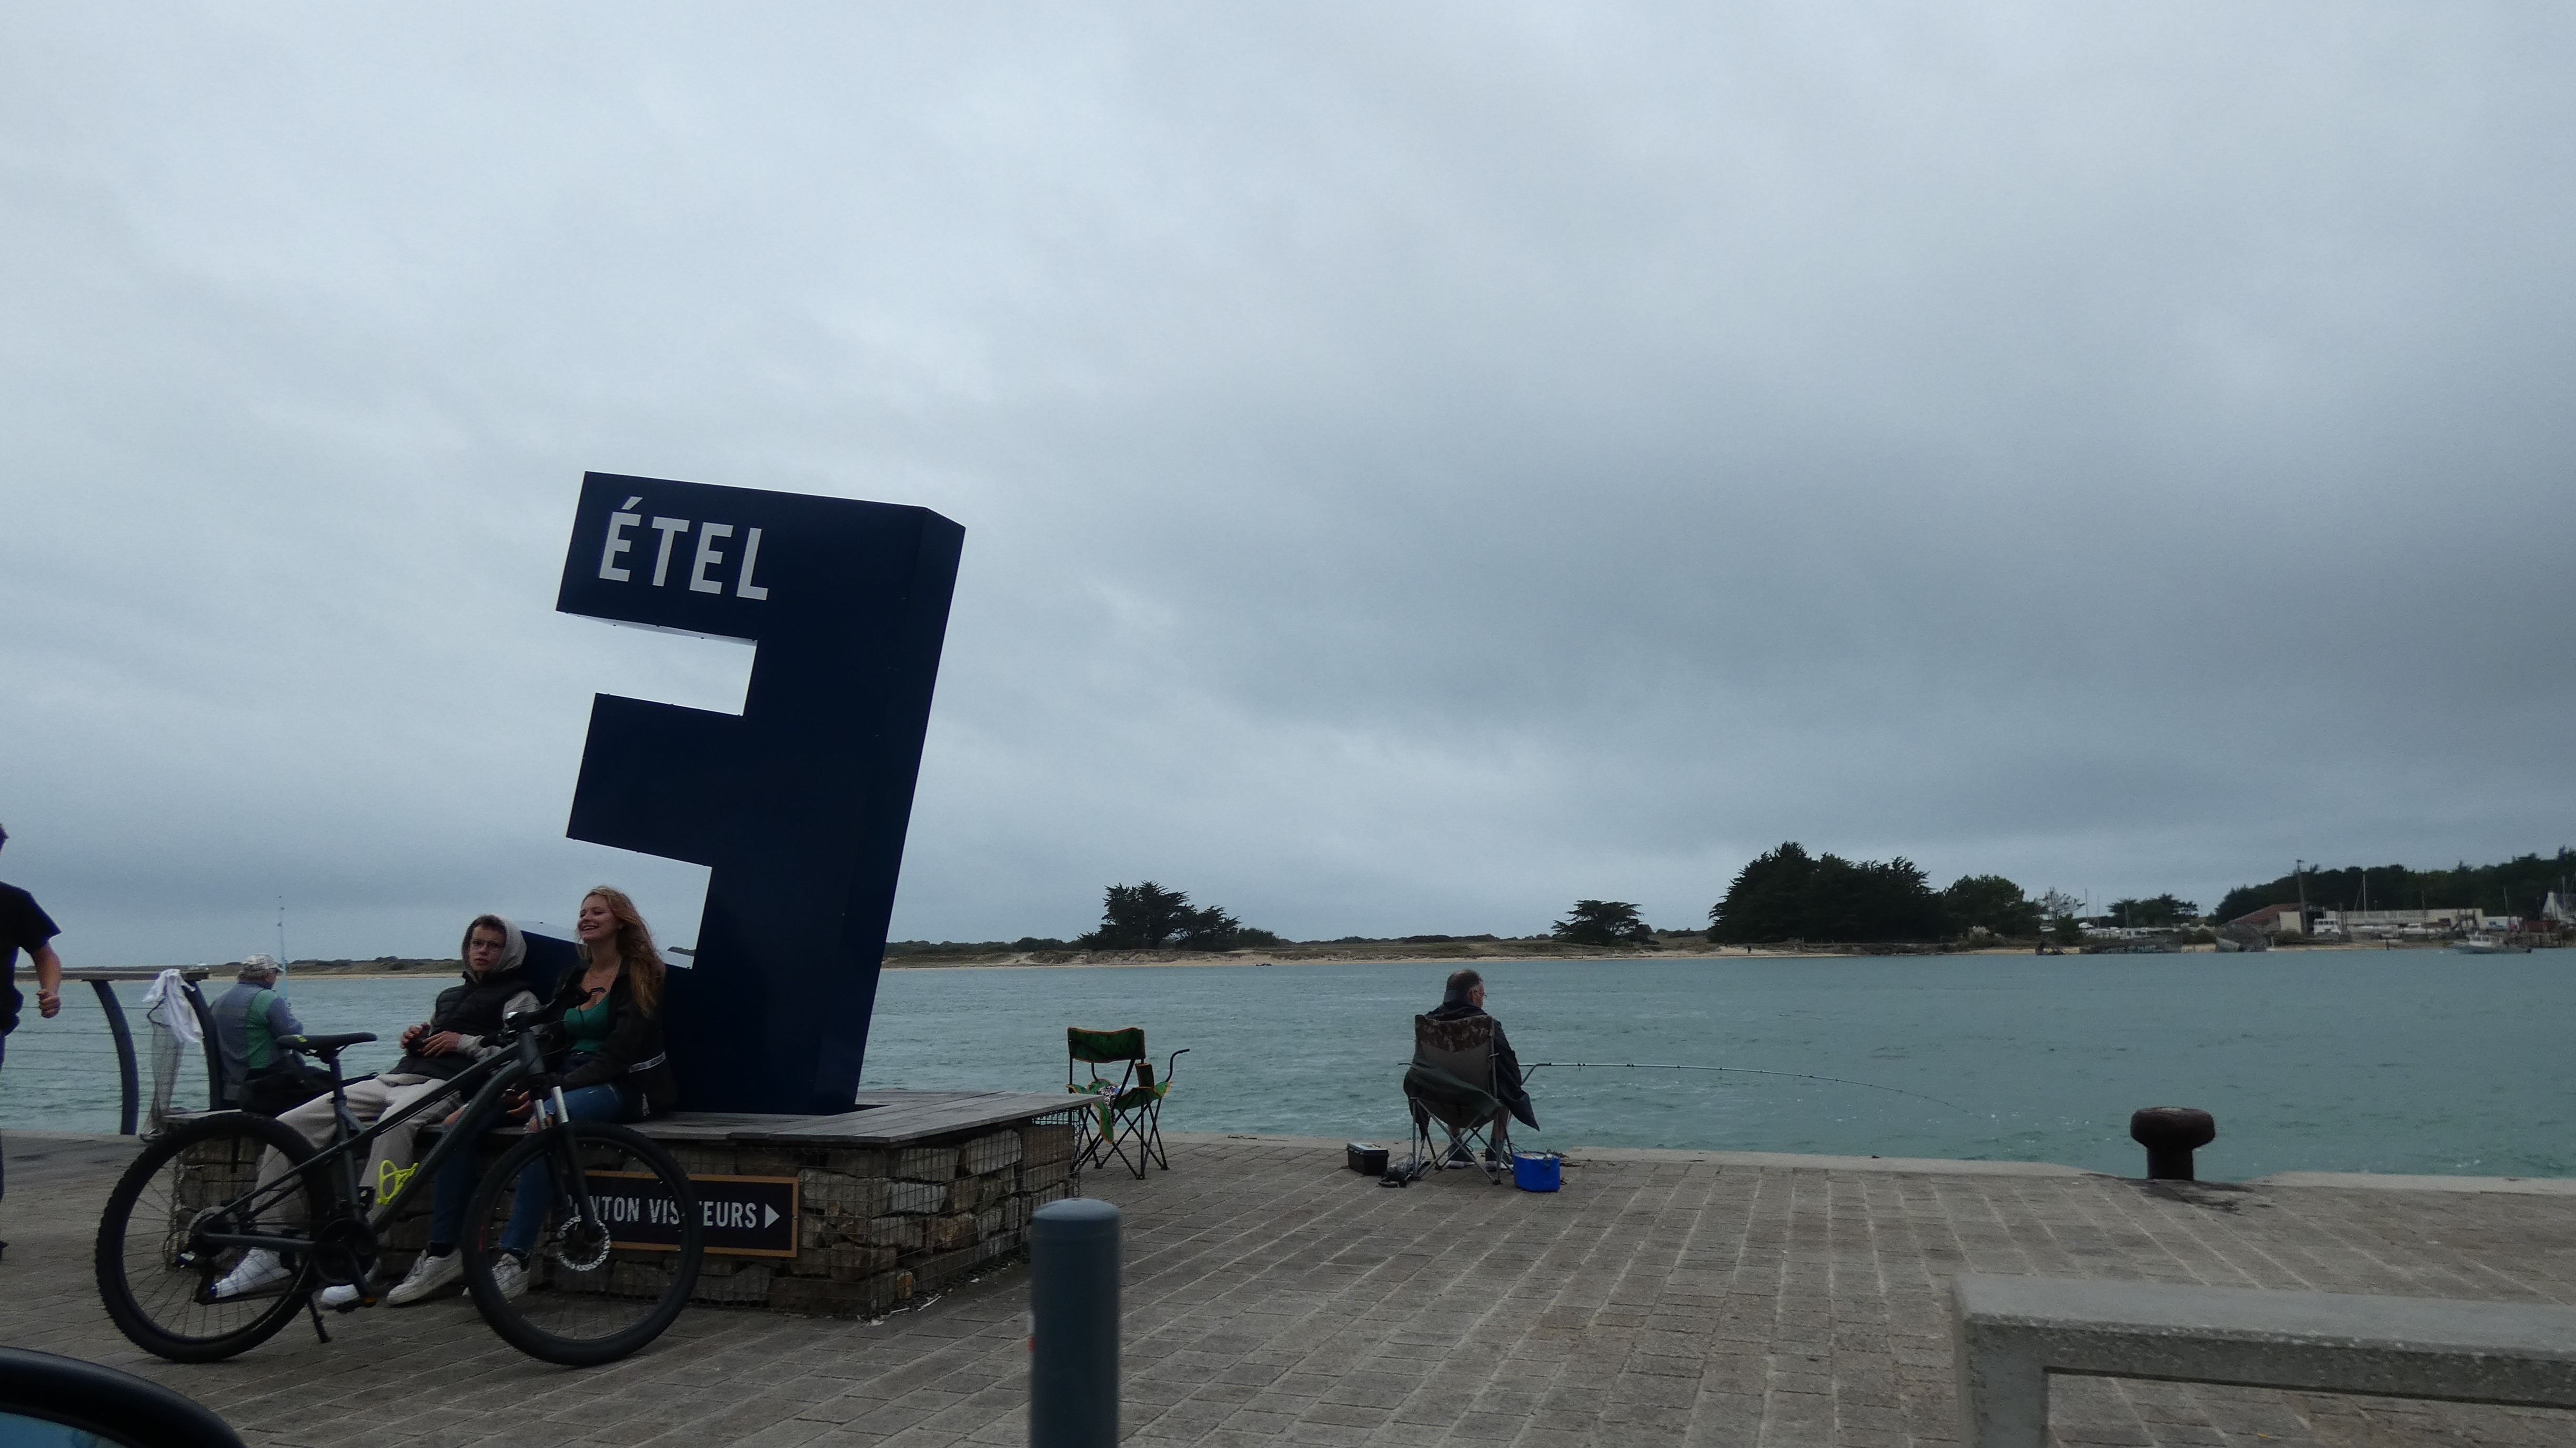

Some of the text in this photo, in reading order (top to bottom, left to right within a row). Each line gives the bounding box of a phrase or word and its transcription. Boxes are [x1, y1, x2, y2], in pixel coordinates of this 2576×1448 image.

[598, 496, 769, 601] ÉTEL
[567, 1194, 758, 1229] NTON VISEURS
